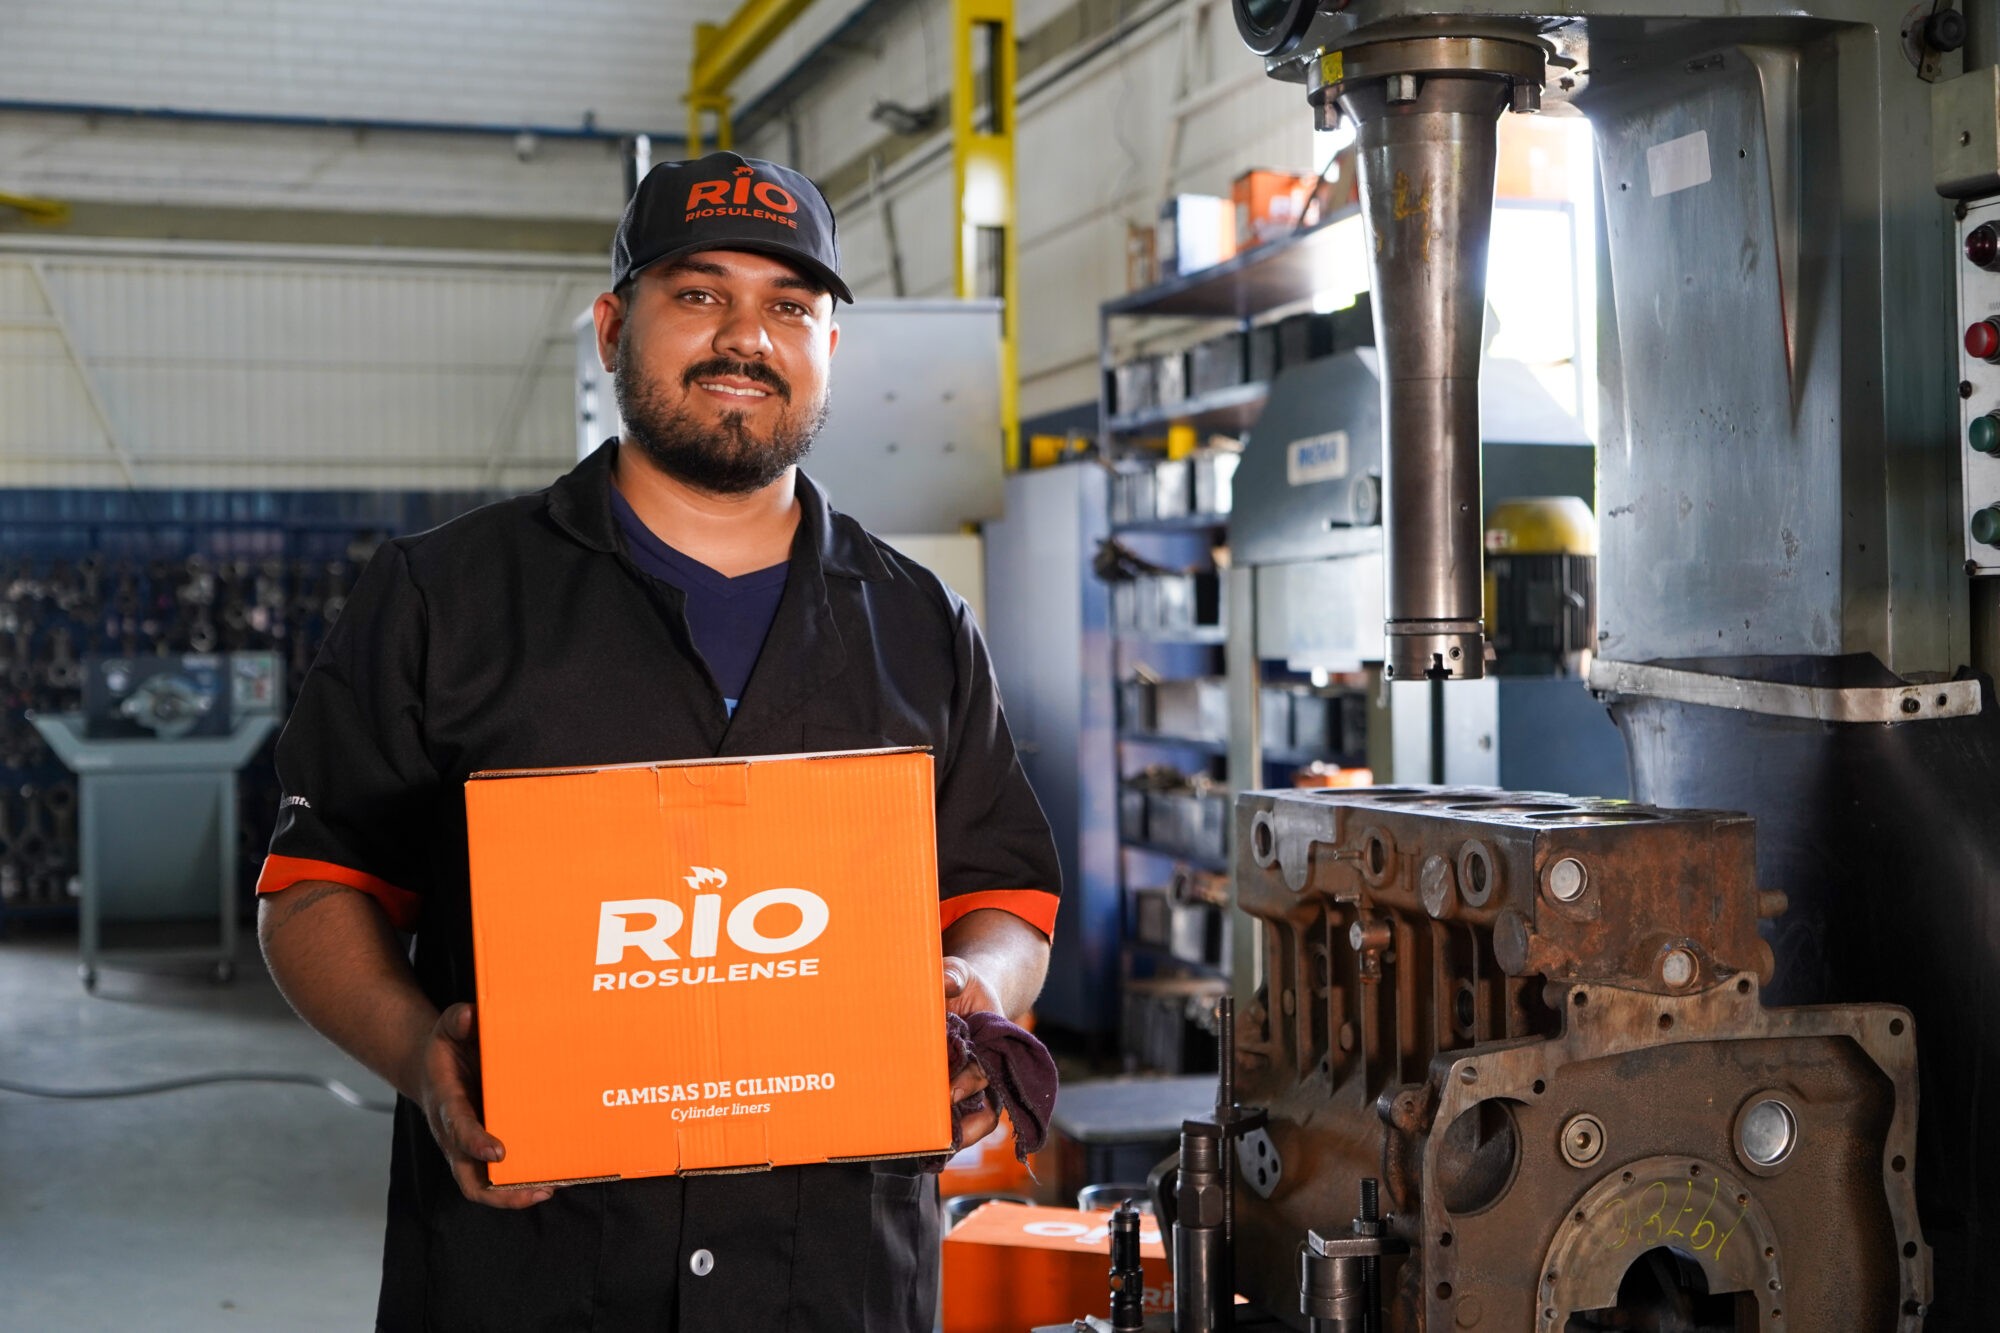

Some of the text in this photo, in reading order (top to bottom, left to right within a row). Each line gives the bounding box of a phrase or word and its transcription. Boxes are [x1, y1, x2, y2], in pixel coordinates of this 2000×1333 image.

[685, 166, 798, 214] RIO
[685, 207, 798, 230] RIOSULENSE
[595, 865, 830, 965] RIO
[592, 958, 820, 992] RIOSULENSE
[602, 1073, 836, 1107] CAMISAS DE CILINDRO
[671, 1103, 771, 1122] Cylinder liners
